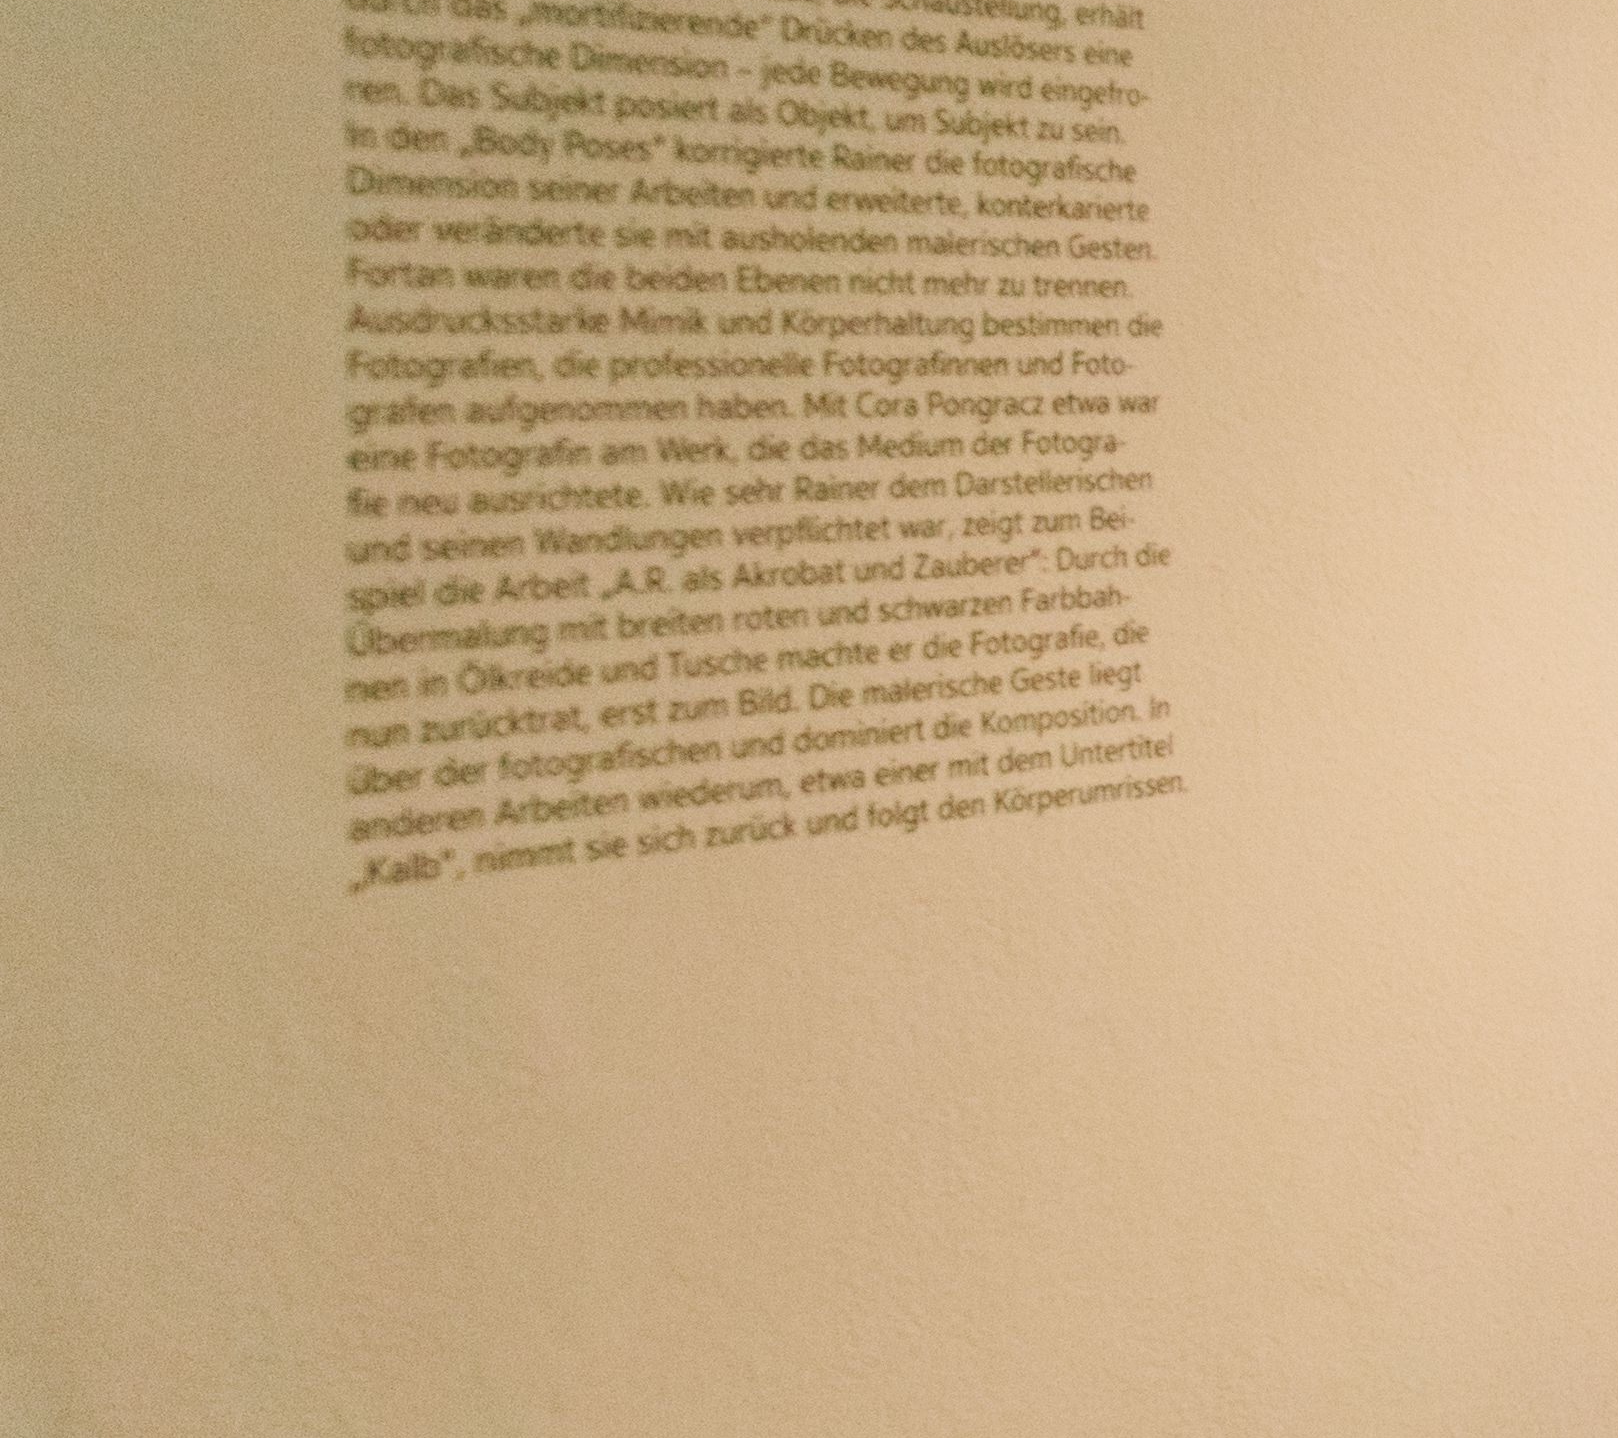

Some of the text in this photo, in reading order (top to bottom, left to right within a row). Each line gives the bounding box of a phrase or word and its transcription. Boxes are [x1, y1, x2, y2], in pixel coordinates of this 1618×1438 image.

[1073, 0, 1144, 31] erhält
[778, 14, 1133, 69] Drücken des Auslösers eine
[759, 56, 1153, 112] jede Bewegung wird eingefro-
[726, 97, 768, 127] als
[883, 112, 927, 135] um
[932, 108, 1029, 146] Subjekt
[1035, 121, 1065, 143] zu
[1069, 118, 1128, 146] sein.
[829, 142, 1136, 187] Rainer die fotografische
[761, 182, 819, 212] und
[974, 190, 1149, 223] konterkarierte
[905, 229, 1159, 262] malerischen Gesten.
[733, 264, 1135, 300] Ebenen nicht mehr zu trennen.
[779, 308, 1163, 345] Körperhaltung bestimmen die
[821, 350, 1133, 386] Fotografinnen und Foto-
[801, 391, 1159, 426] Mit Cora Pongracz etwa war
[746, 429, 1125, 463] die das Medium der Fotogra-
[791, 467, 1153, 504] Rainer dem Darstellerischen
[731, 506, 1135, 554] verpflichtet war, zeigt zum Bei-
[731, 558, 845, 592] Akrobat
[852, 555, 906, 586] und
[1054, 545, 1128, 576] Durch
[1134, 544, 1171, 572] die
[731, 583, 1134, 633] roten und schwarzen Farbbah-
[775, 621, 1149, 673] machte er die Fotografie, die
[806, 681, 853, 713] Die
[860, 671, 1003, 708] malerische
[1008, 668, 1081, 697] Geste
[1087, 662, 1141, 696] liegt
[791, 697, 1171, 756] dominiert die Komposition. In
[798, 734, 1174, 797] etwa einer mit dem Untertitel
[804, 776, 1191, 838] und folgt den Körperumrissen.
